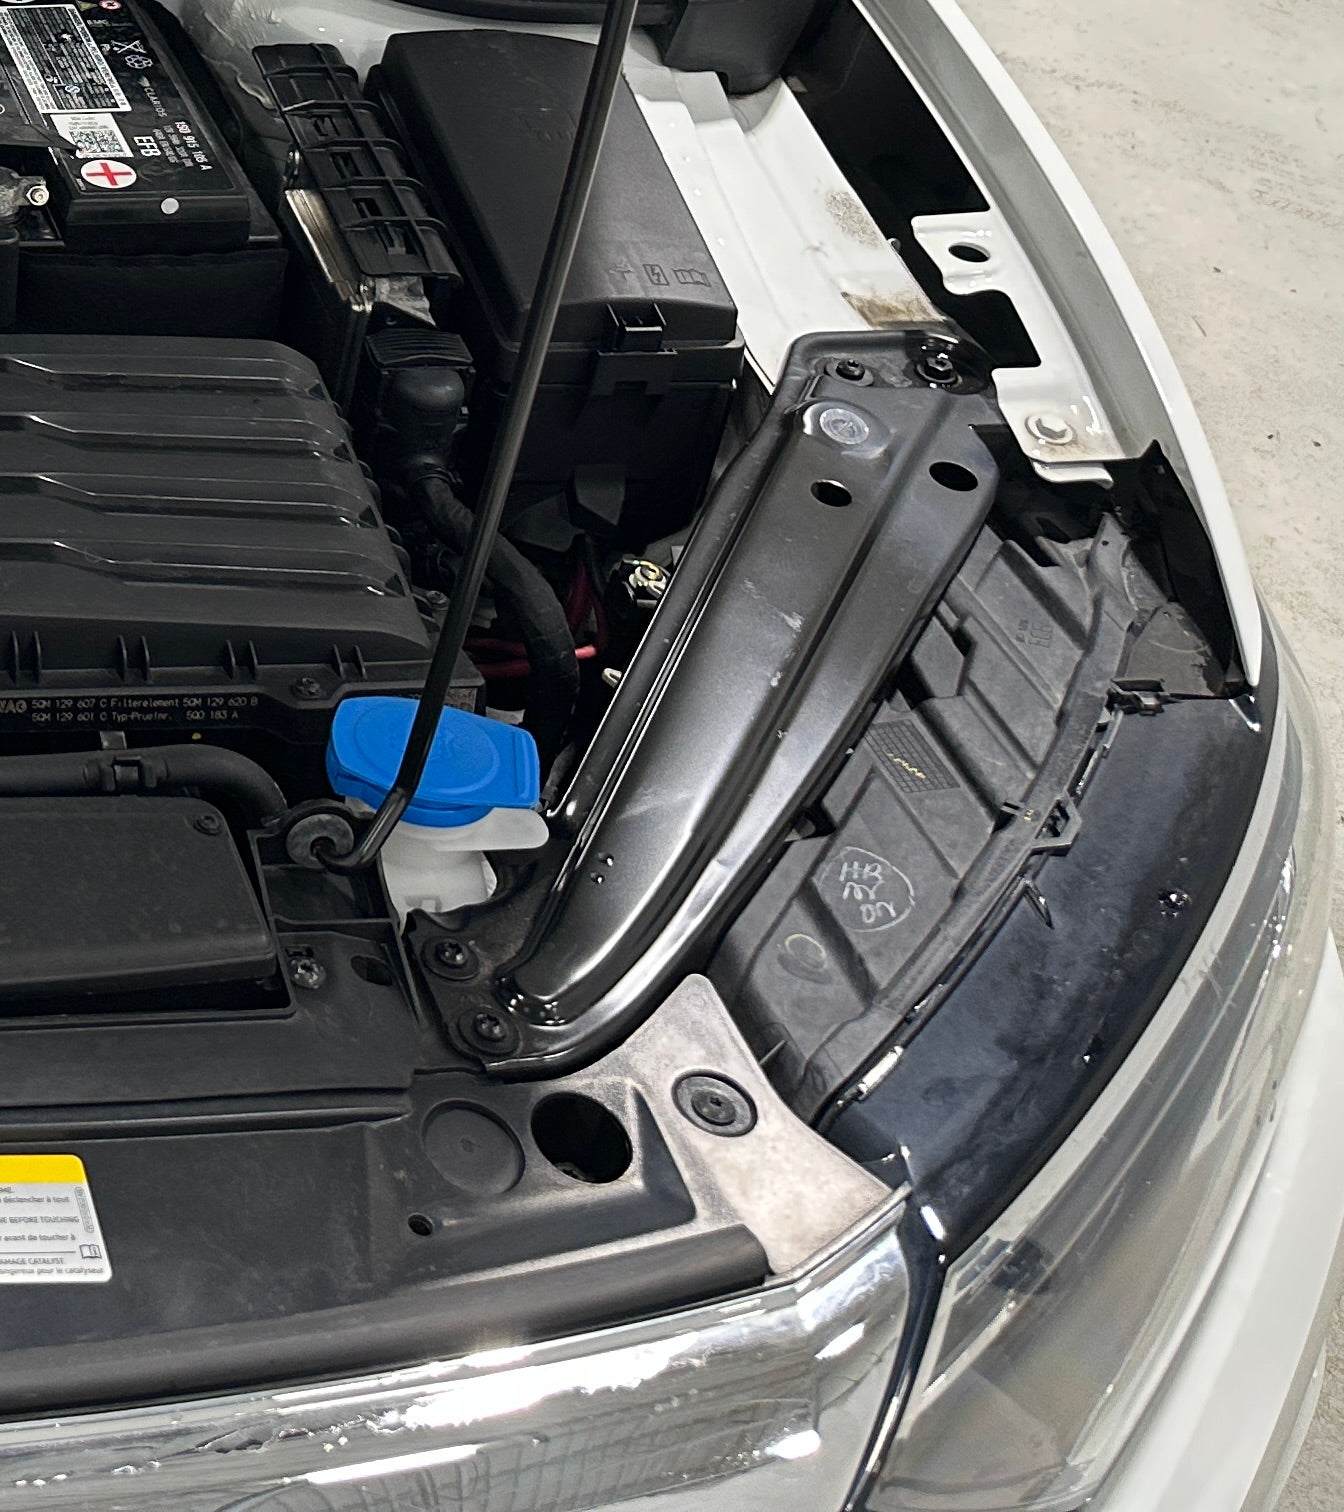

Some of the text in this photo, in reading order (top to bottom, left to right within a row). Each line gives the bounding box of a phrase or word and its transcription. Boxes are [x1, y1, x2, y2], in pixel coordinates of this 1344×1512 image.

[133, 136, 162, 157] EFB
[56, 699, 73, 709] 129
[77, 698, 96, 709] 607
[99, 698, 107, 708] C
[111, 697, 179, 708] Filterelement
[207, 696, 223, 706] 129
[56, 712, 73, 722] 129
[99, 712, 107, 721] C
[210, 710, 228, 720] 183
[232, 710, 239, 720] A
